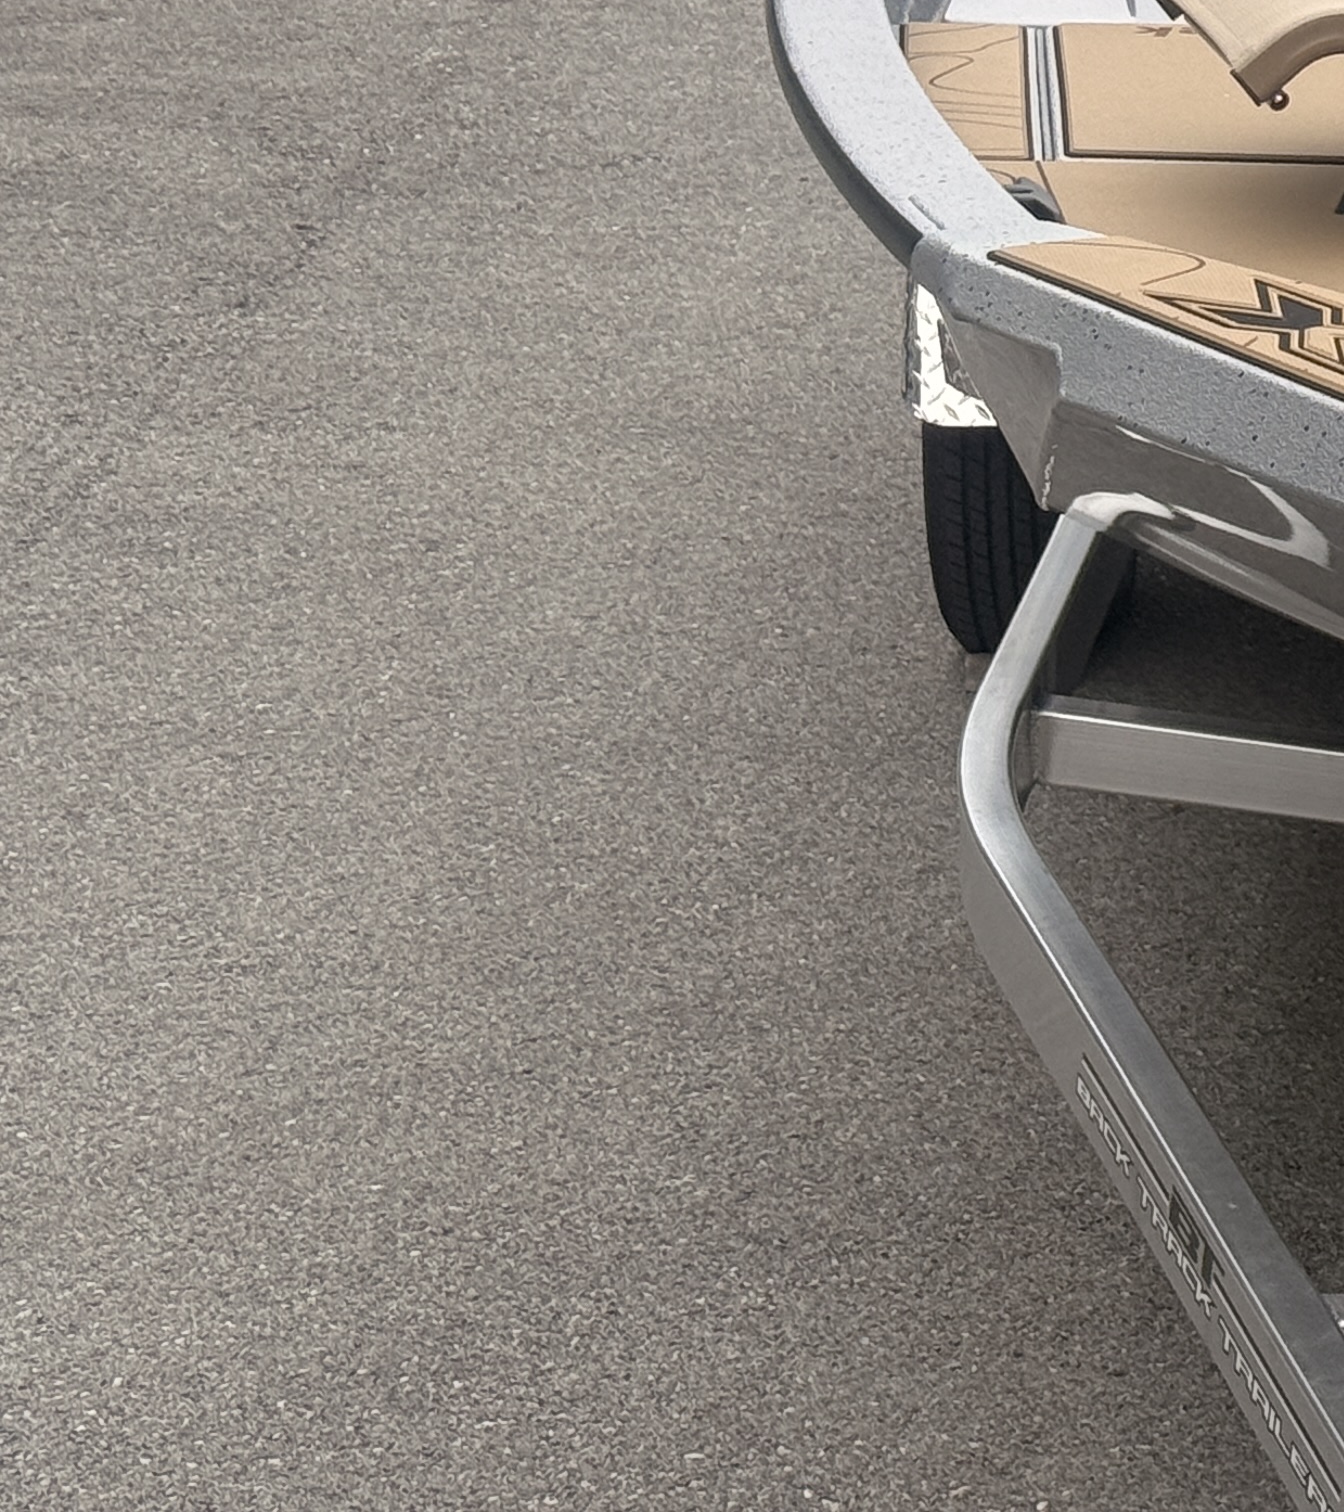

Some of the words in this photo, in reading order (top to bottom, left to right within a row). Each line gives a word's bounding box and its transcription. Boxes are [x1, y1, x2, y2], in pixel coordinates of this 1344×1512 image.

[1076, 1073, 1132, 1177] BACK
[1137, 1176, 1216, 1319] TRACK
[1218, 1314, 1333, 1512] TRAILER
